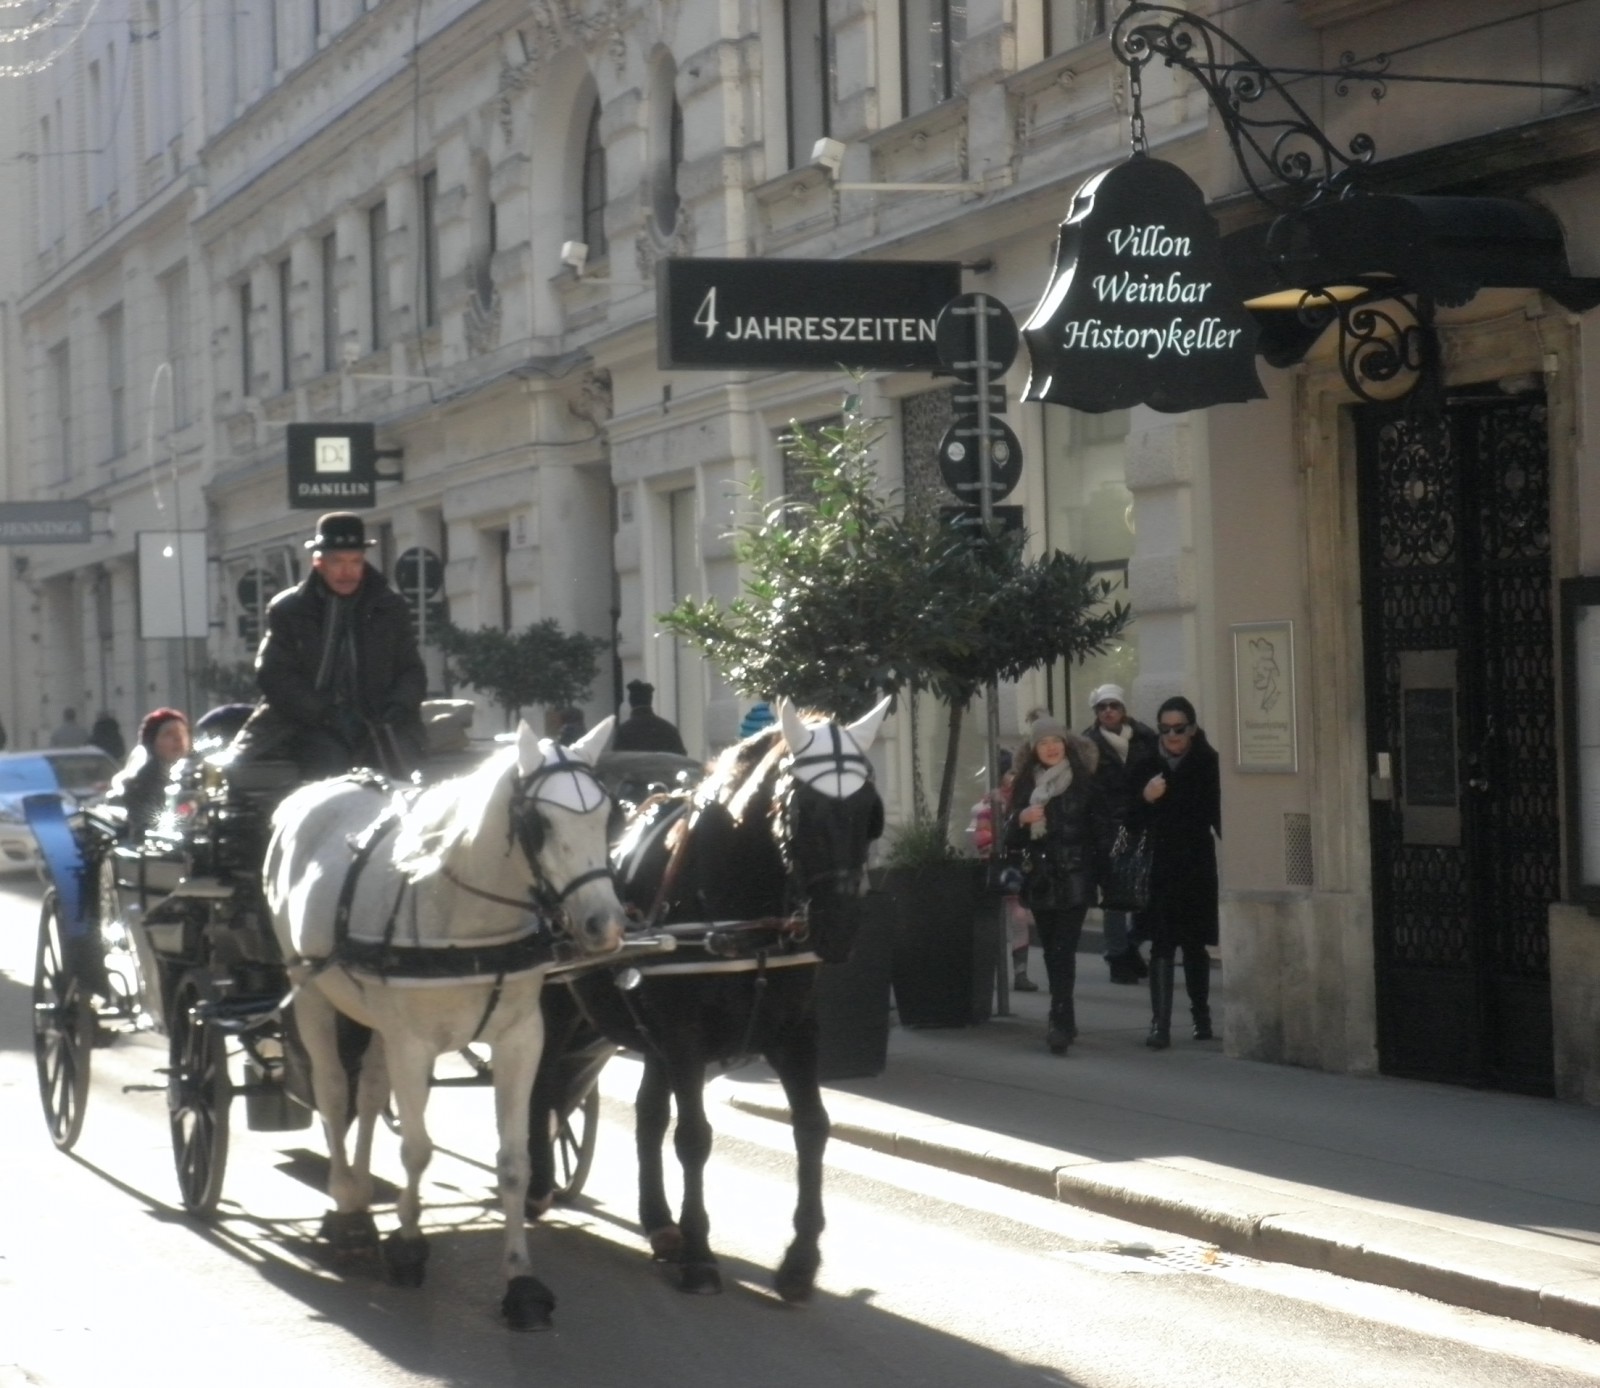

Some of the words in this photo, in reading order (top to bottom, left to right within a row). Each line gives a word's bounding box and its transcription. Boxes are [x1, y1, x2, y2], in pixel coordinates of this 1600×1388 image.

[1107, 225, 1191, 257] Villon
[1092, 271, 1211, 303] Weinbar
[693, 286, 720, 339] 4
[726, 316, 937, 342] JAHRESZEITEN
[1062, 317, 1242, 359] Historykeller
[298, 482, 370, 496] DANILIN
